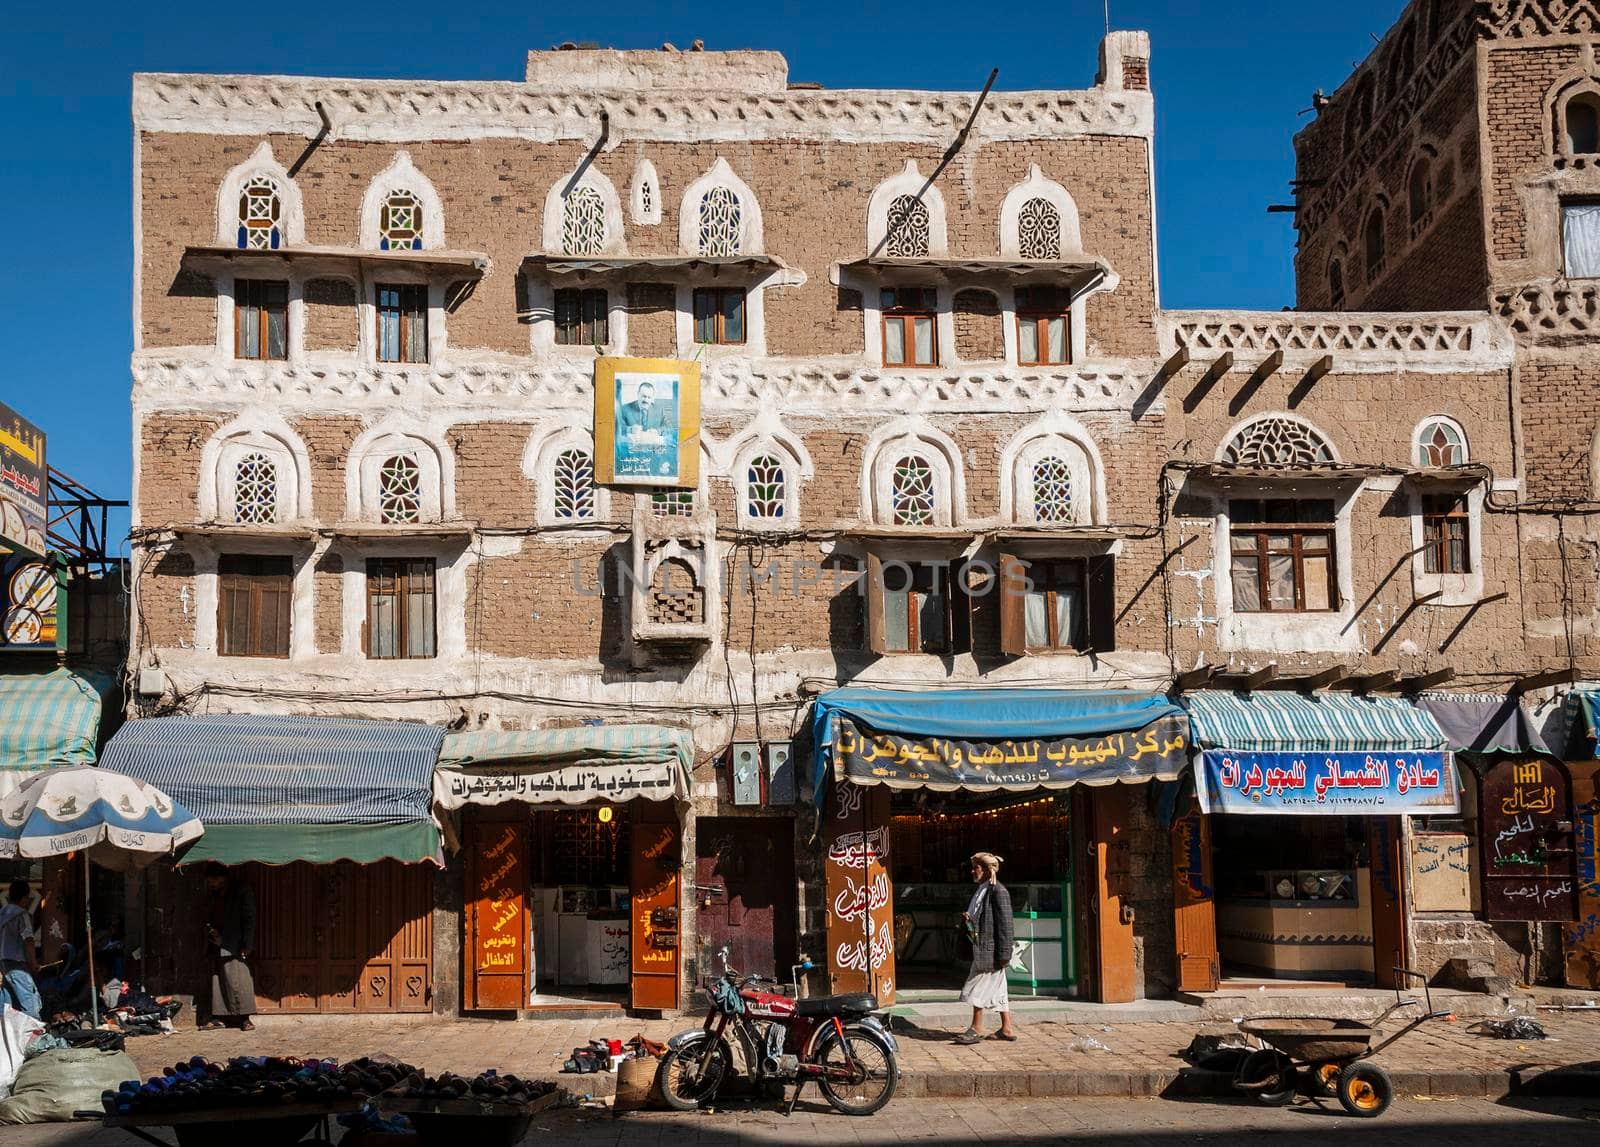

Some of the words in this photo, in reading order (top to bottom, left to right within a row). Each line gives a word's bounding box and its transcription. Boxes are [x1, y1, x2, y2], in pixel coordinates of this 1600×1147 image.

[836, 730, 963, 769] والمجوهرات
[967, 739, 1040, 770] للذهب
[1046, 734, 1126, 767] المهيوب
[1129, 730, 1184, 762] مركز
[451, 771, 526, 799] والمجوهرات
[530, 769, 587, 798] للذهب
[1219, 757, 1307, 798] للمجوهرات
[1314, 754, 1390, 803] الشمساني
[1396, 757, 1440, 795] صادق
[1501, 785, 1556, 815] الصالح
[492, 901, 519, 932] الذهب
[642, 950, 673, 964] الذهب
